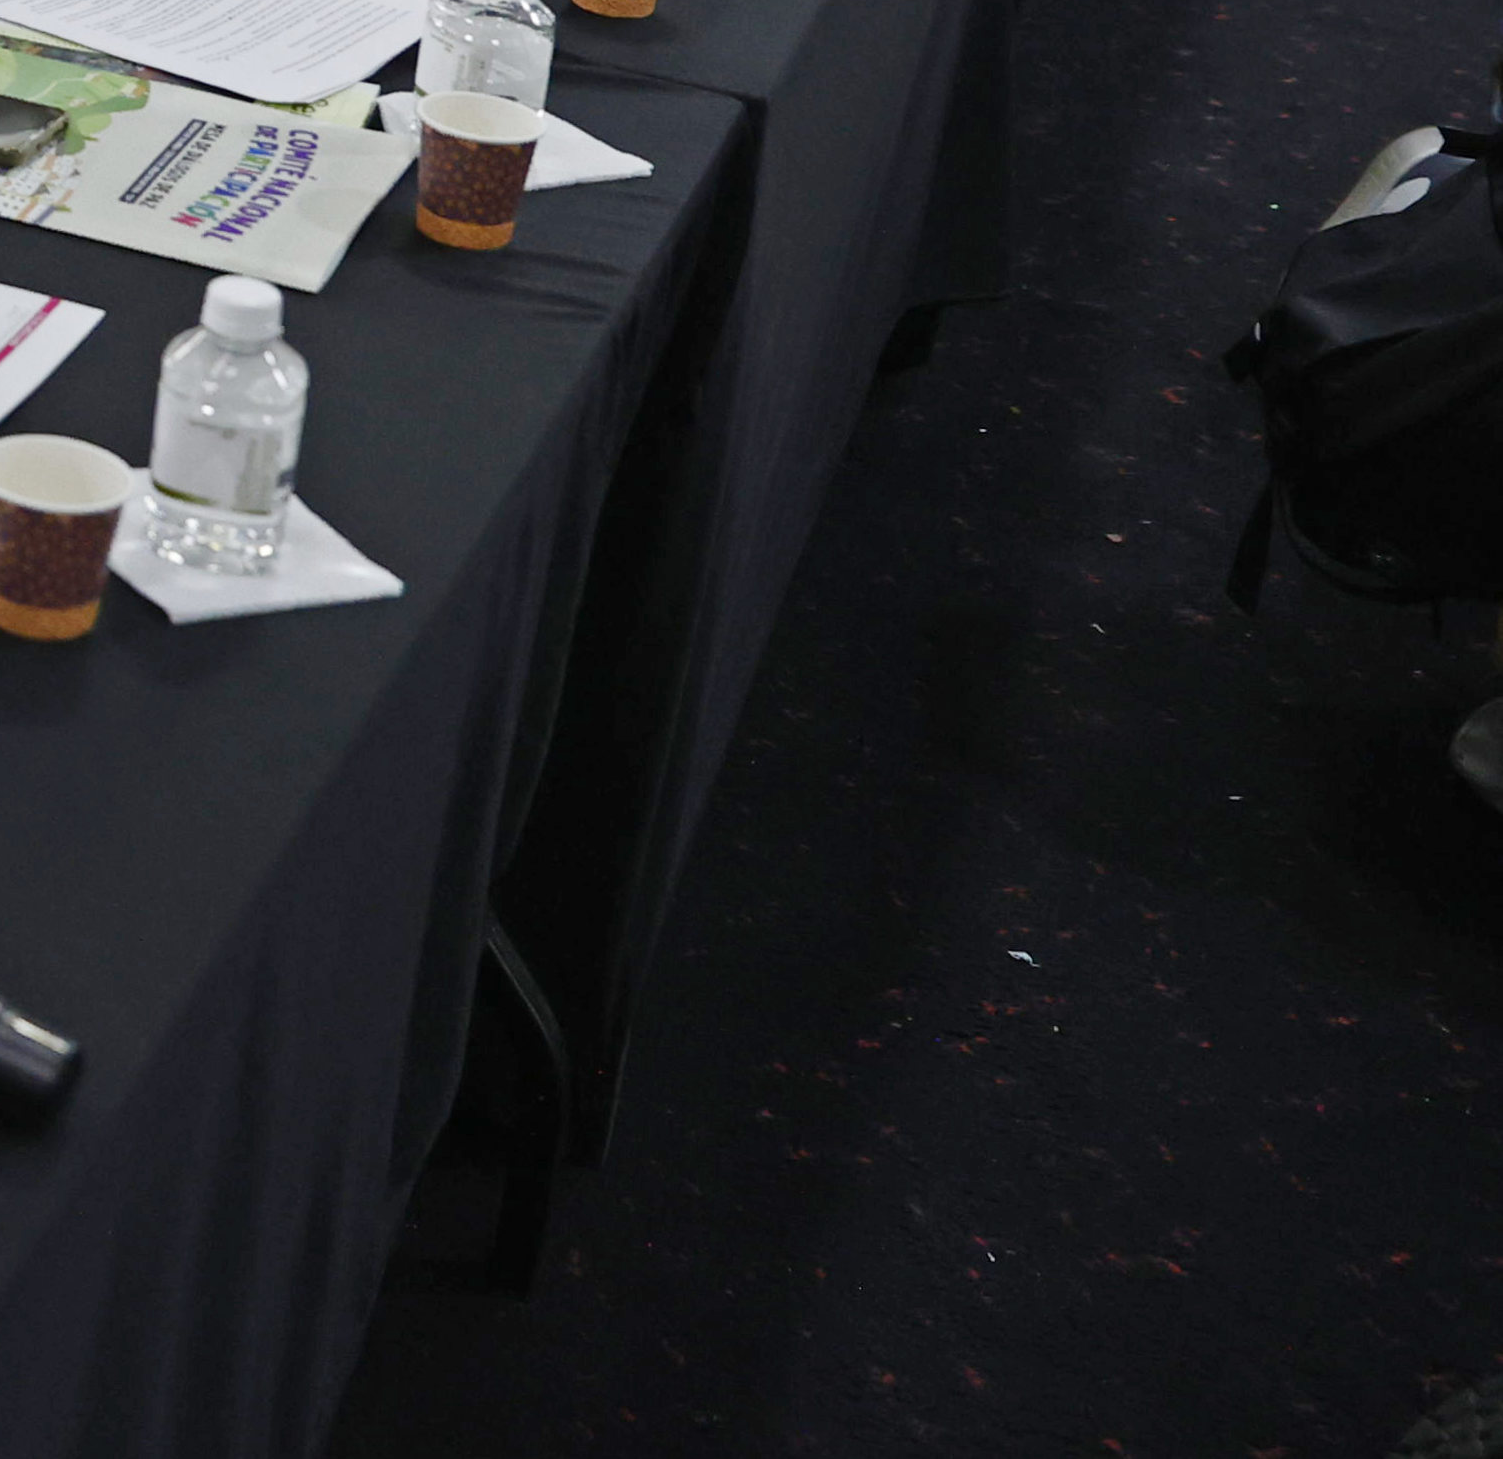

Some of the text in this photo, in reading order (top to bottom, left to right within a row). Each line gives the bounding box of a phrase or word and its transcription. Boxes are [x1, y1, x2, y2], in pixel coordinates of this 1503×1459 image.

[170, 124, 280, 228] DE PARTICIPACIÓN
[272, 129, 320, 181] COMITÉ
[201, 176, 300, 242] NACIONAL
